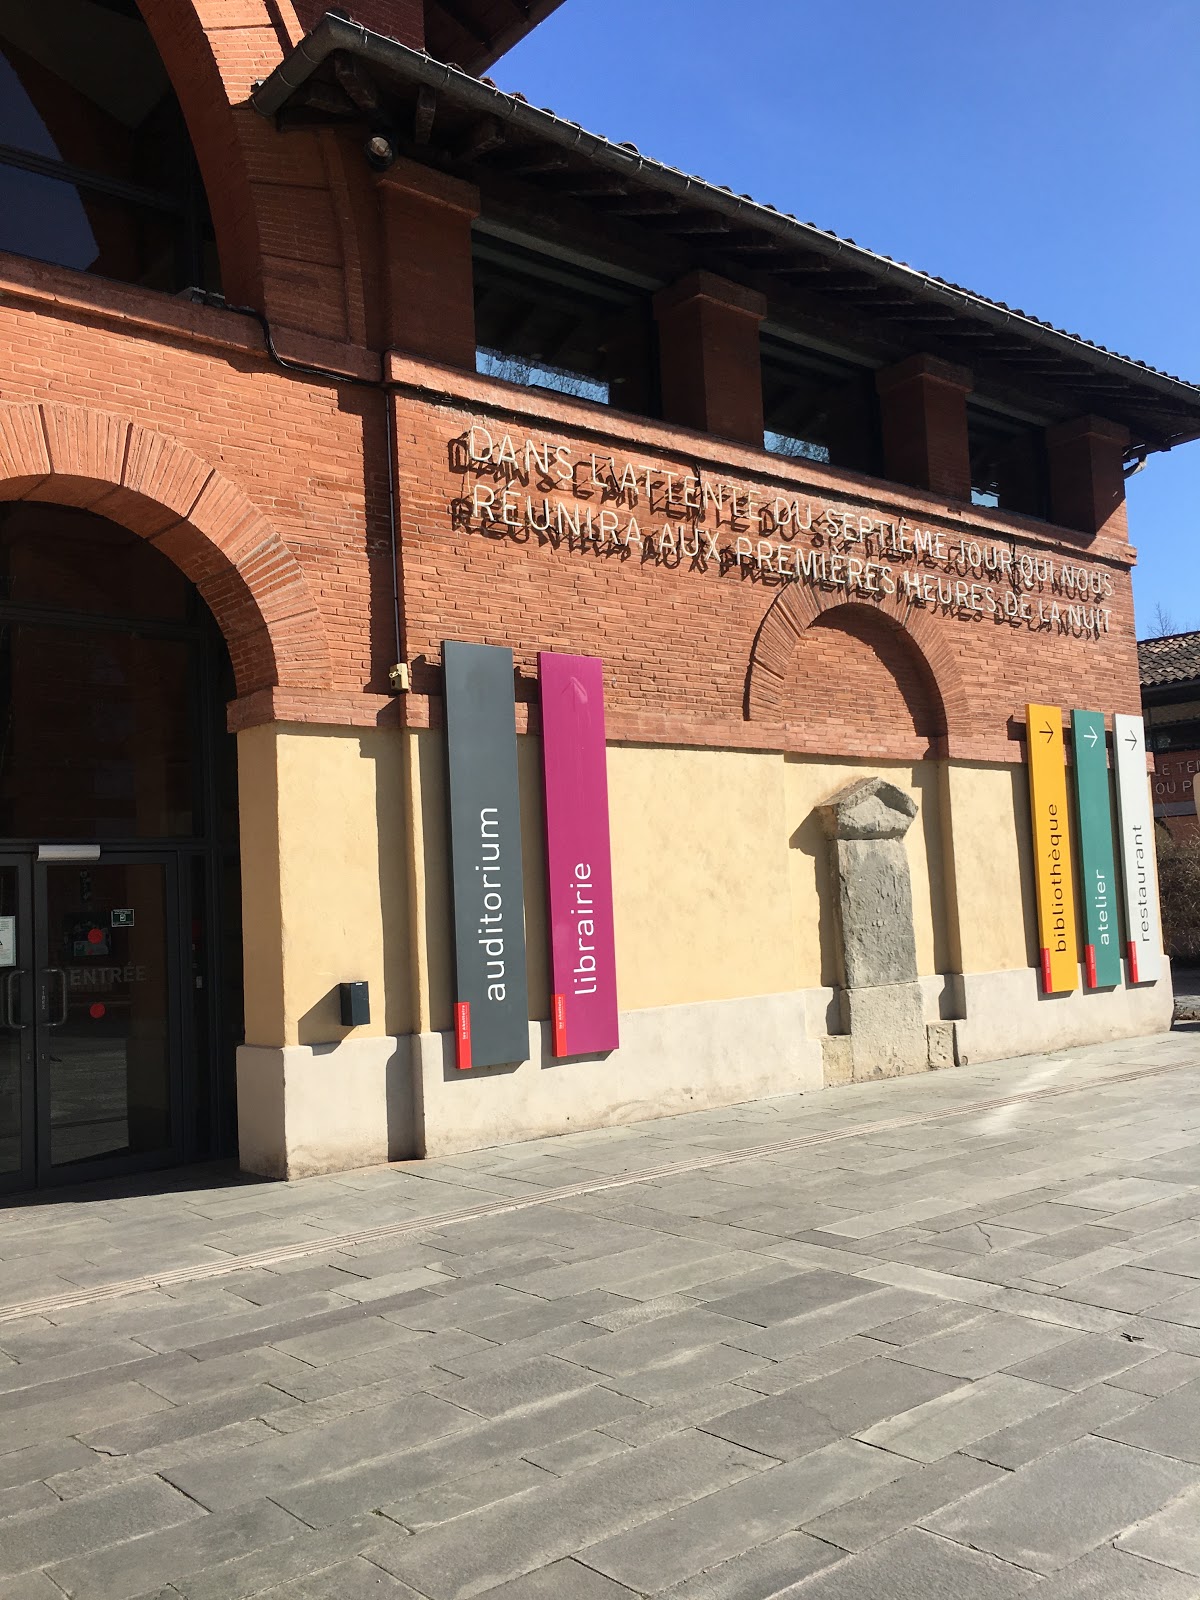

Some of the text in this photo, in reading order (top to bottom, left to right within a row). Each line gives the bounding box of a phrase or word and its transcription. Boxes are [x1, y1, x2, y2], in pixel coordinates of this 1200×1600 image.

[470, 425, 1113, 597] DANS L'ATTENTE DU SEPTIÈME JOUR QUI NOUS
[473, 480, 1113, 632] RÉUNIRA AUX PREMIÈRES HEURES DE LA NUIT
[1155, 782, 1176, 795] OU
[475, 807, 506, 1001] auditorium
[569, 862, 597, 995] librairie
[1047, 803, 1067, 953] bibliothèque
[1095, 869, 1110, 945] atelier
[1133, 824, 1151, 942] restaurant
[69, 961, 147, 986] ENTRÉE
